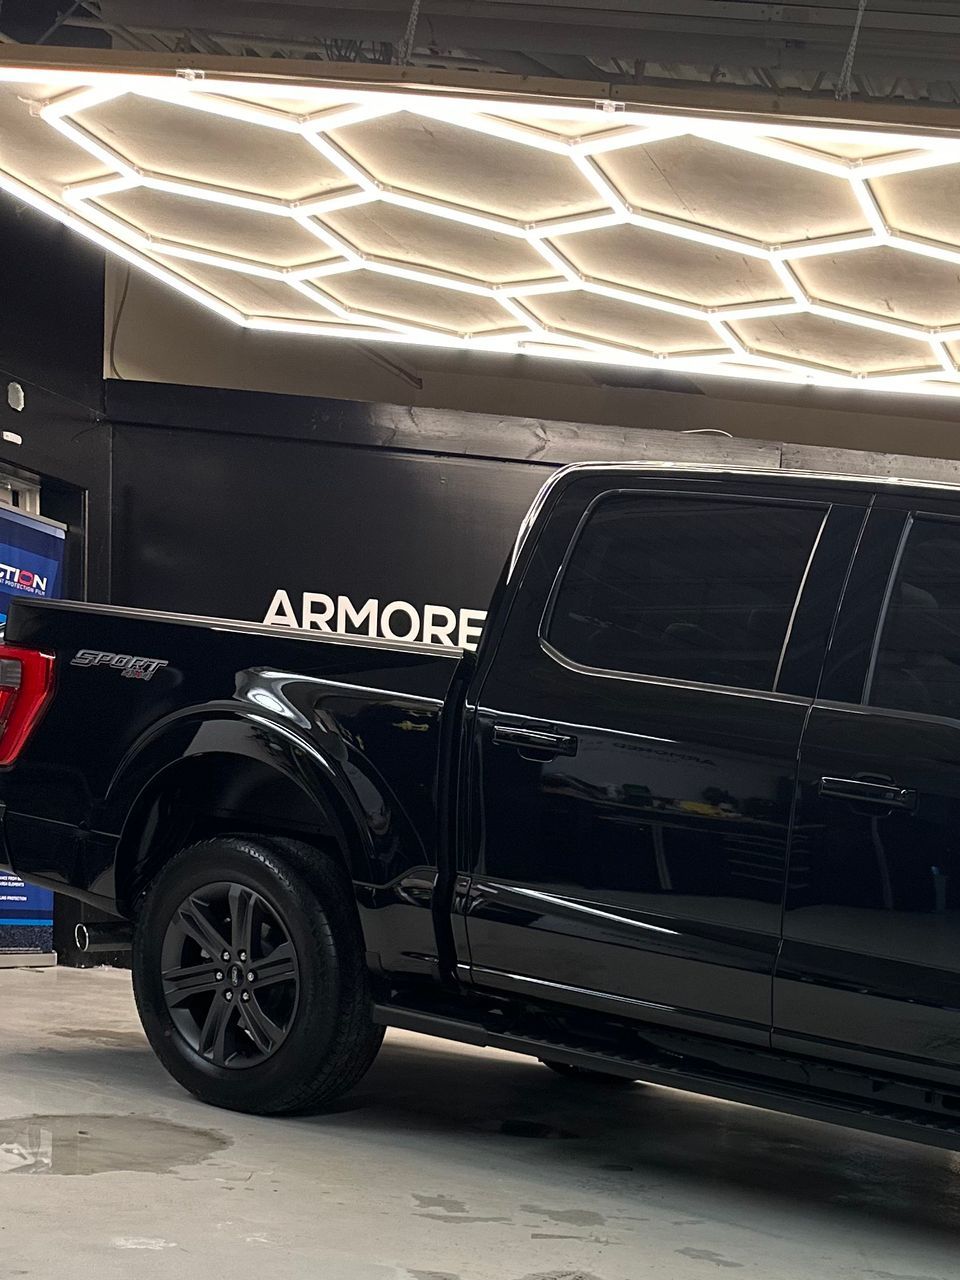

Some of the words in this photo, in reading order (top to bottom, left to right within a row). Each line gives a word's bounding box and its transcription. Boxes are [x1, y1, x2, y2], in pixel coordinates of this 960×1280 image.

[5, 580, 34, 593] PROTECTION
[262, 589, 488, 652] ARMORE
[70, 649, 169, 674] SPORT
